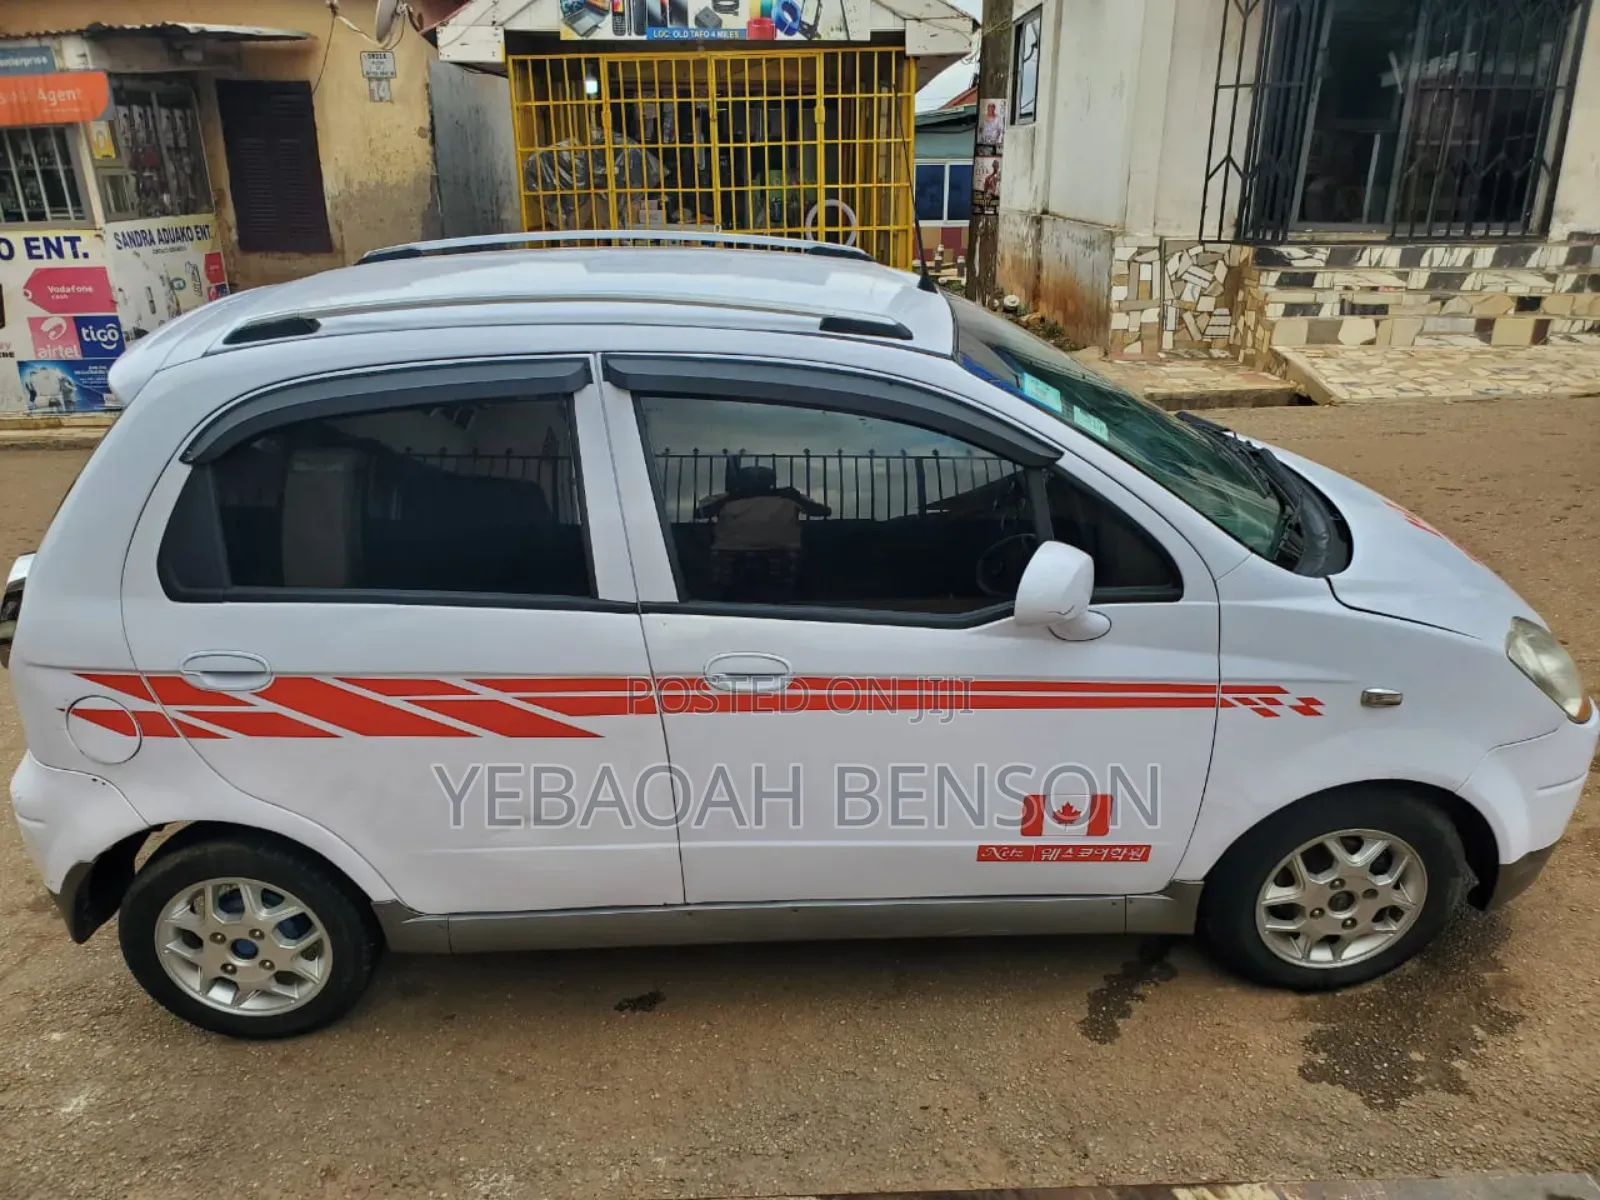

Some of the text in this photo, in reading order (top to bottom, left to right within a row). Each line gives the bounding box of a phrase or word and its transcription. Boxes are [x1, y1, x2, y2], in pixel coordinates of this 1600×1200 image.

[673, 29, 689, 39] OLD
[690, 30, 710, 38] TAFO
[717, 30, 739, 39] MILES
[23, 235, 90, 260] ENT.
[113, 228, 156, 250] SANDRA
[157, 225, 195, 245] ADUAKO
[36, 344, 80, 360] airtel
